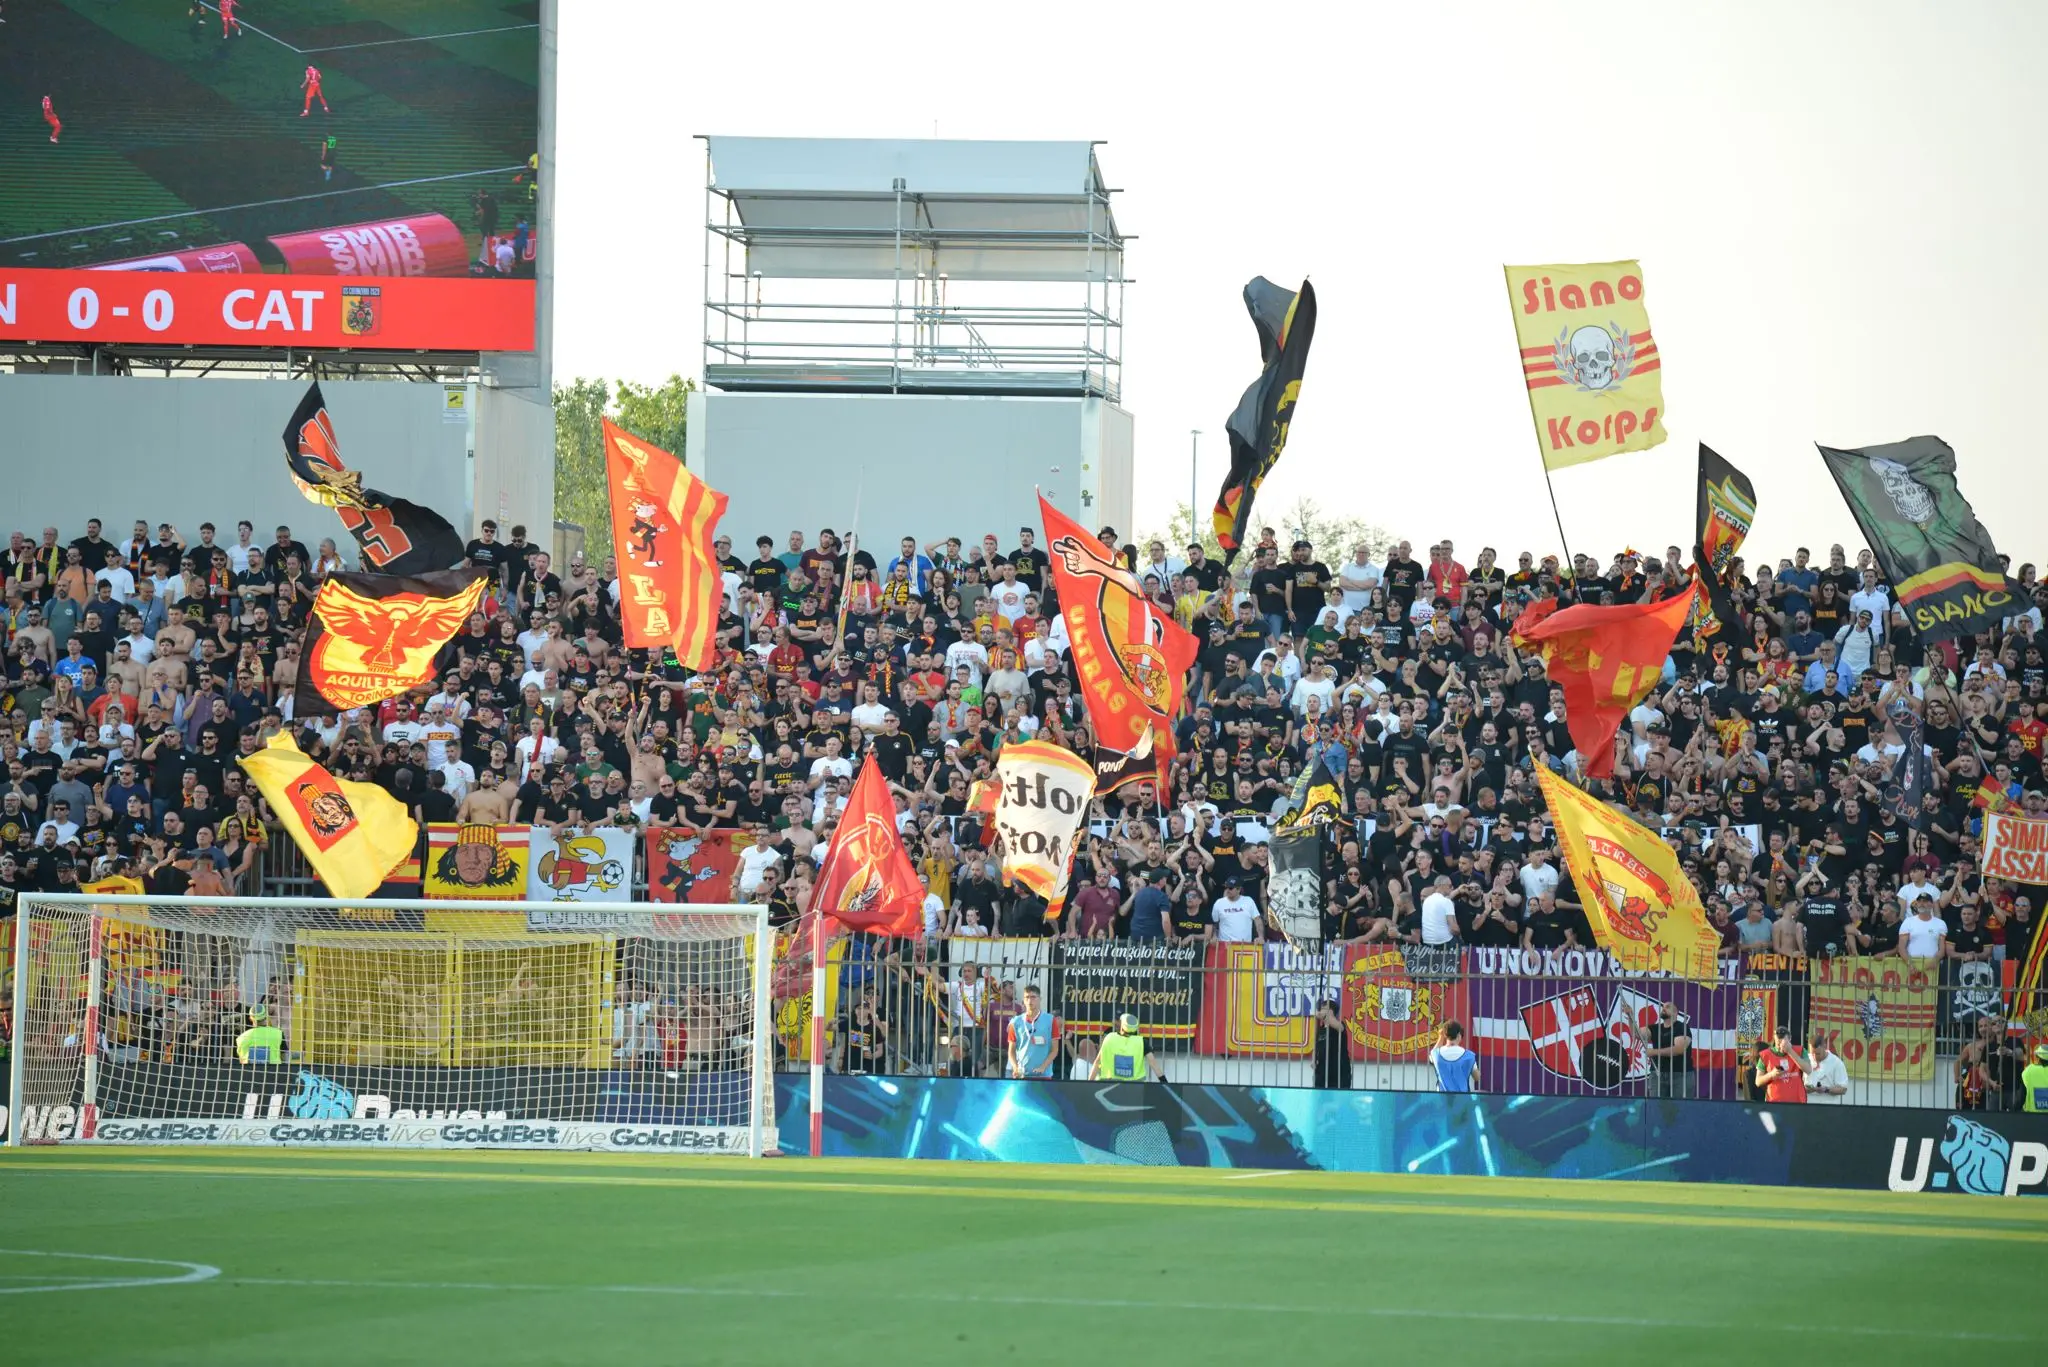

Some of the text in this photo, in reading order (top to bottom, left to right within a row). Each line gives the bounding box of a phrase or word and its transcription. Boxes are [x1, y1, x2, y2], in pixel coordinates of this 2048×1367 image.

[222, 289, 324, 331] CAT
[1522, 275, 1642, 315] Siano
[1547, 407, 1658, 451] Korps
[1915, 590, 2012, 631] SIANO
[1068, 604, 1127, 714] ULTRAS
[325, 674, 383, 689] AQUILE
[349, 688, 394, 702] TORINO
[1060, 985, 1194, 1007] Fratelli Presenti!
[1818, 959, 1929, 994] Siano
[1815, 1028, 1927, 1071] Korps
